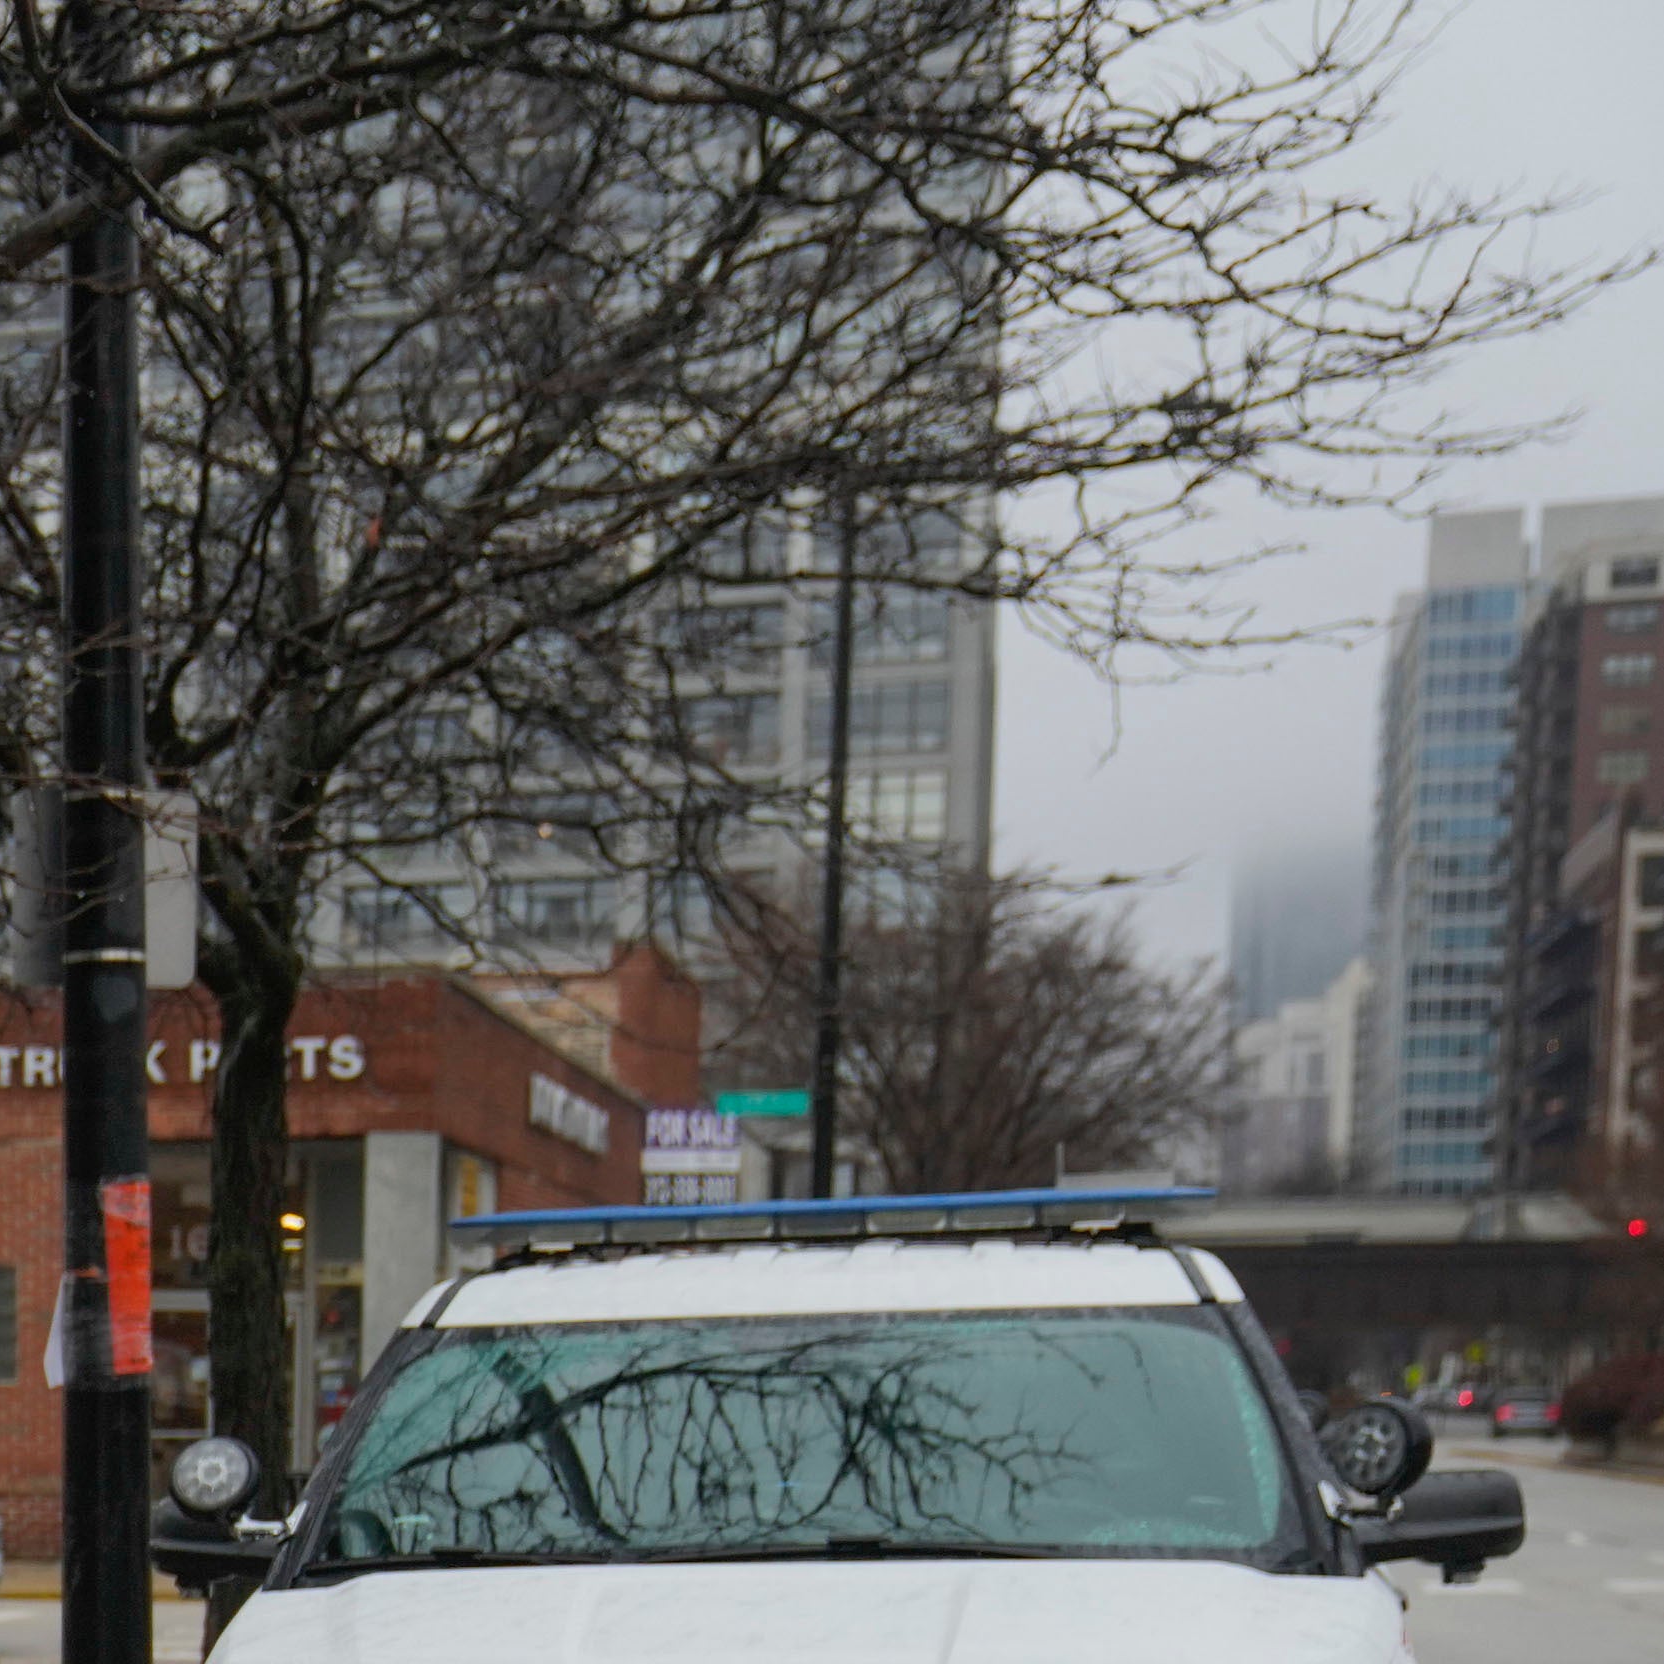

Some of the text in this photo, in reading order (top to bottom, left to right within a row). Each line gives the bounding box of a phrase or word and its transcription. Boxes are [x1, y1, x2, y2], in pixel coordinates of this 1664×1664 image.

[188, 1034, 366, 1082] PTS
[646, 1110, 686, 1147] FOR
[688, 1109, 738, 1147] SALE
